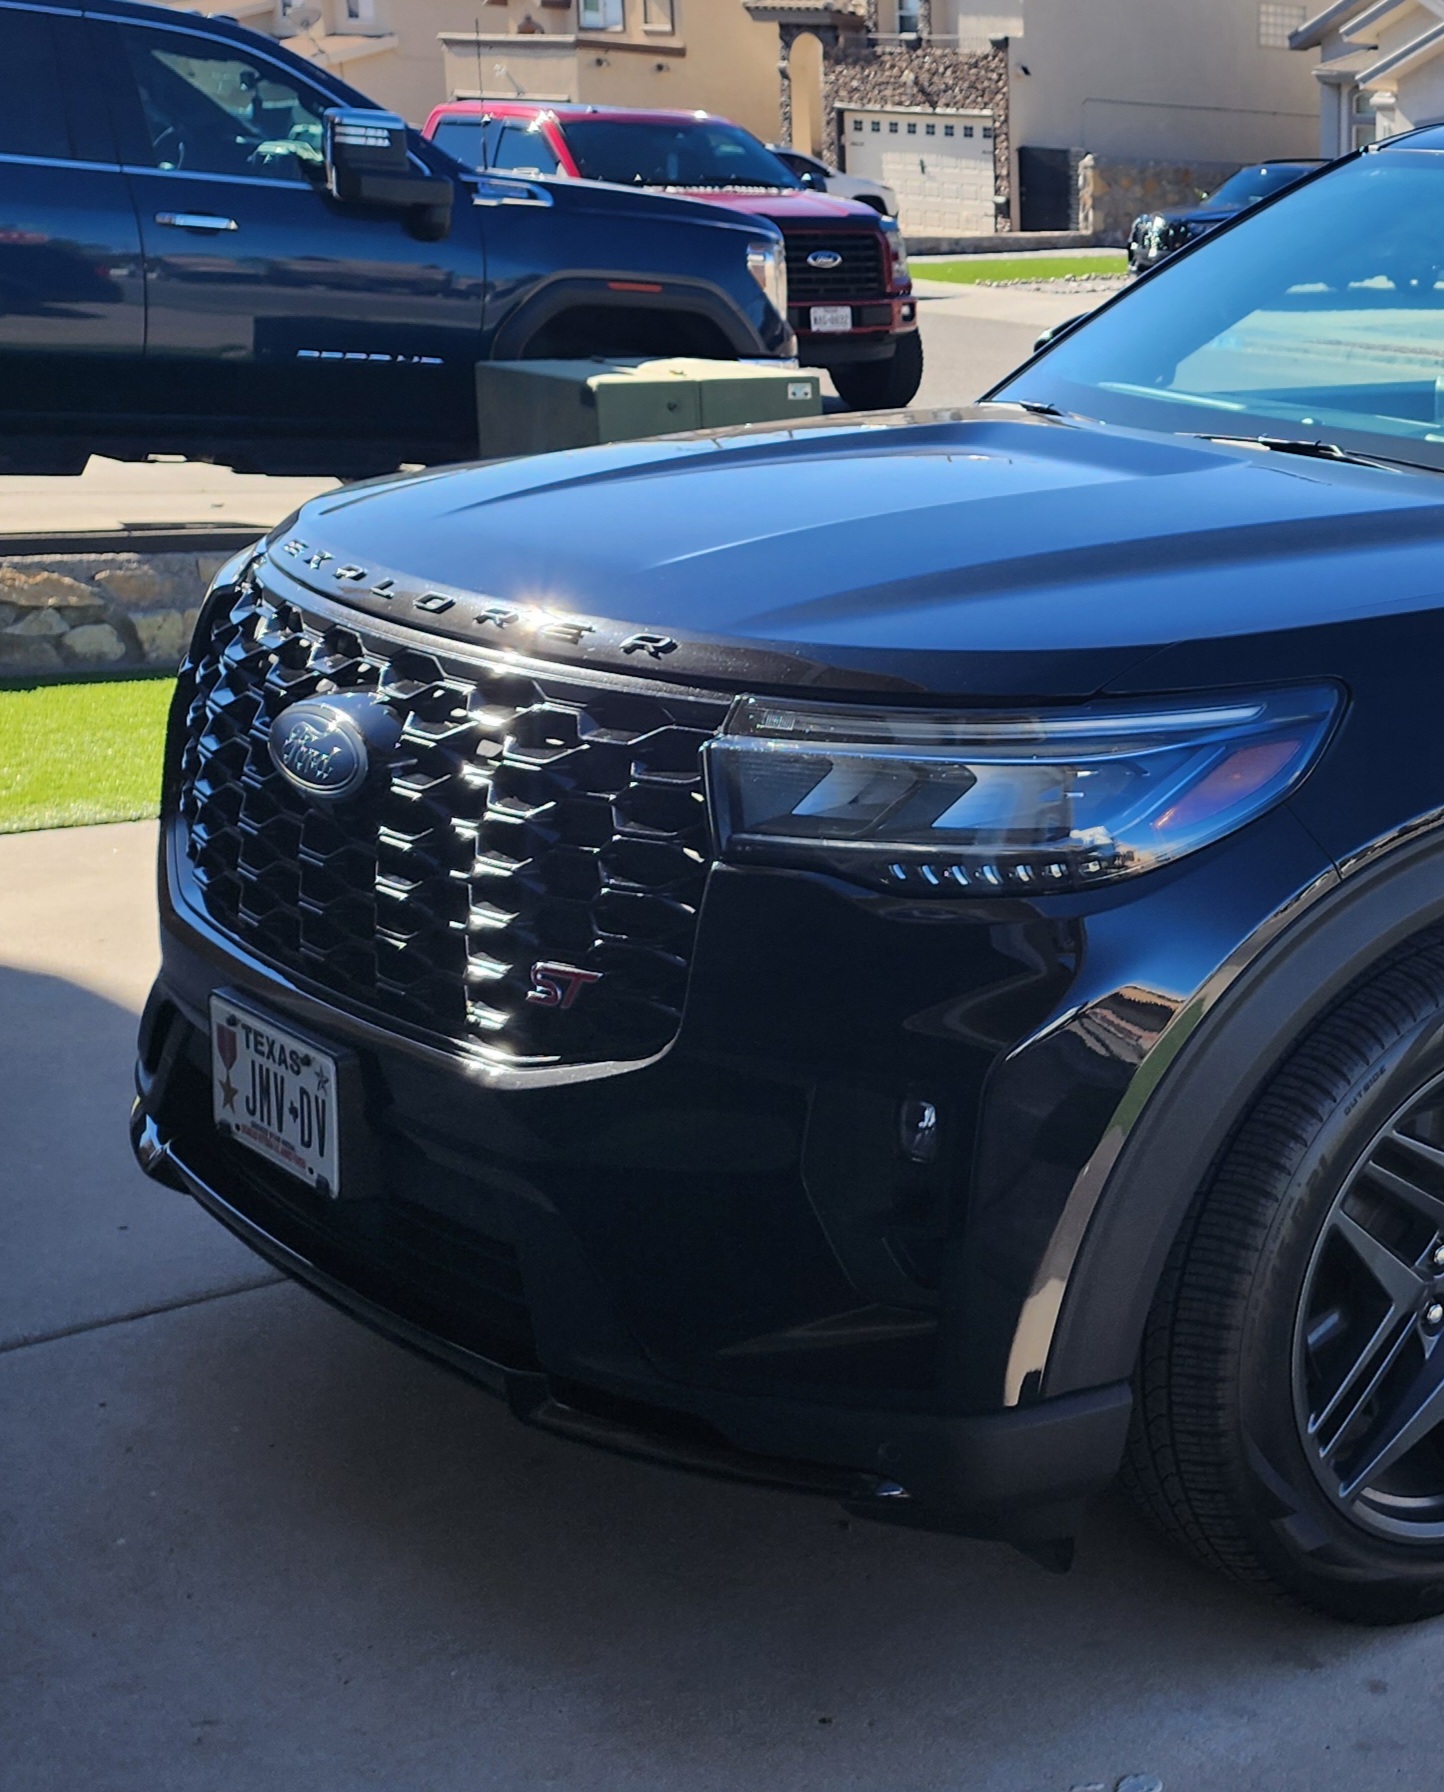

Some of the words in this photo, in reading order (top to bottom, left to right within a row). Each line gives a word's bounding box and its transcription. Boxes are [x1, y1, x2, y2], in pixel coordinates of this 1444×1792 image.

[282, 538, 682, 660] EXPLORER
[282, 720, 342, 780] Ford
[525, 959, 605, 1009] ST
[241, 1022, 302, 1077] TEXAS
[1343, 1064, 1388, 1117] OUTSIDE
